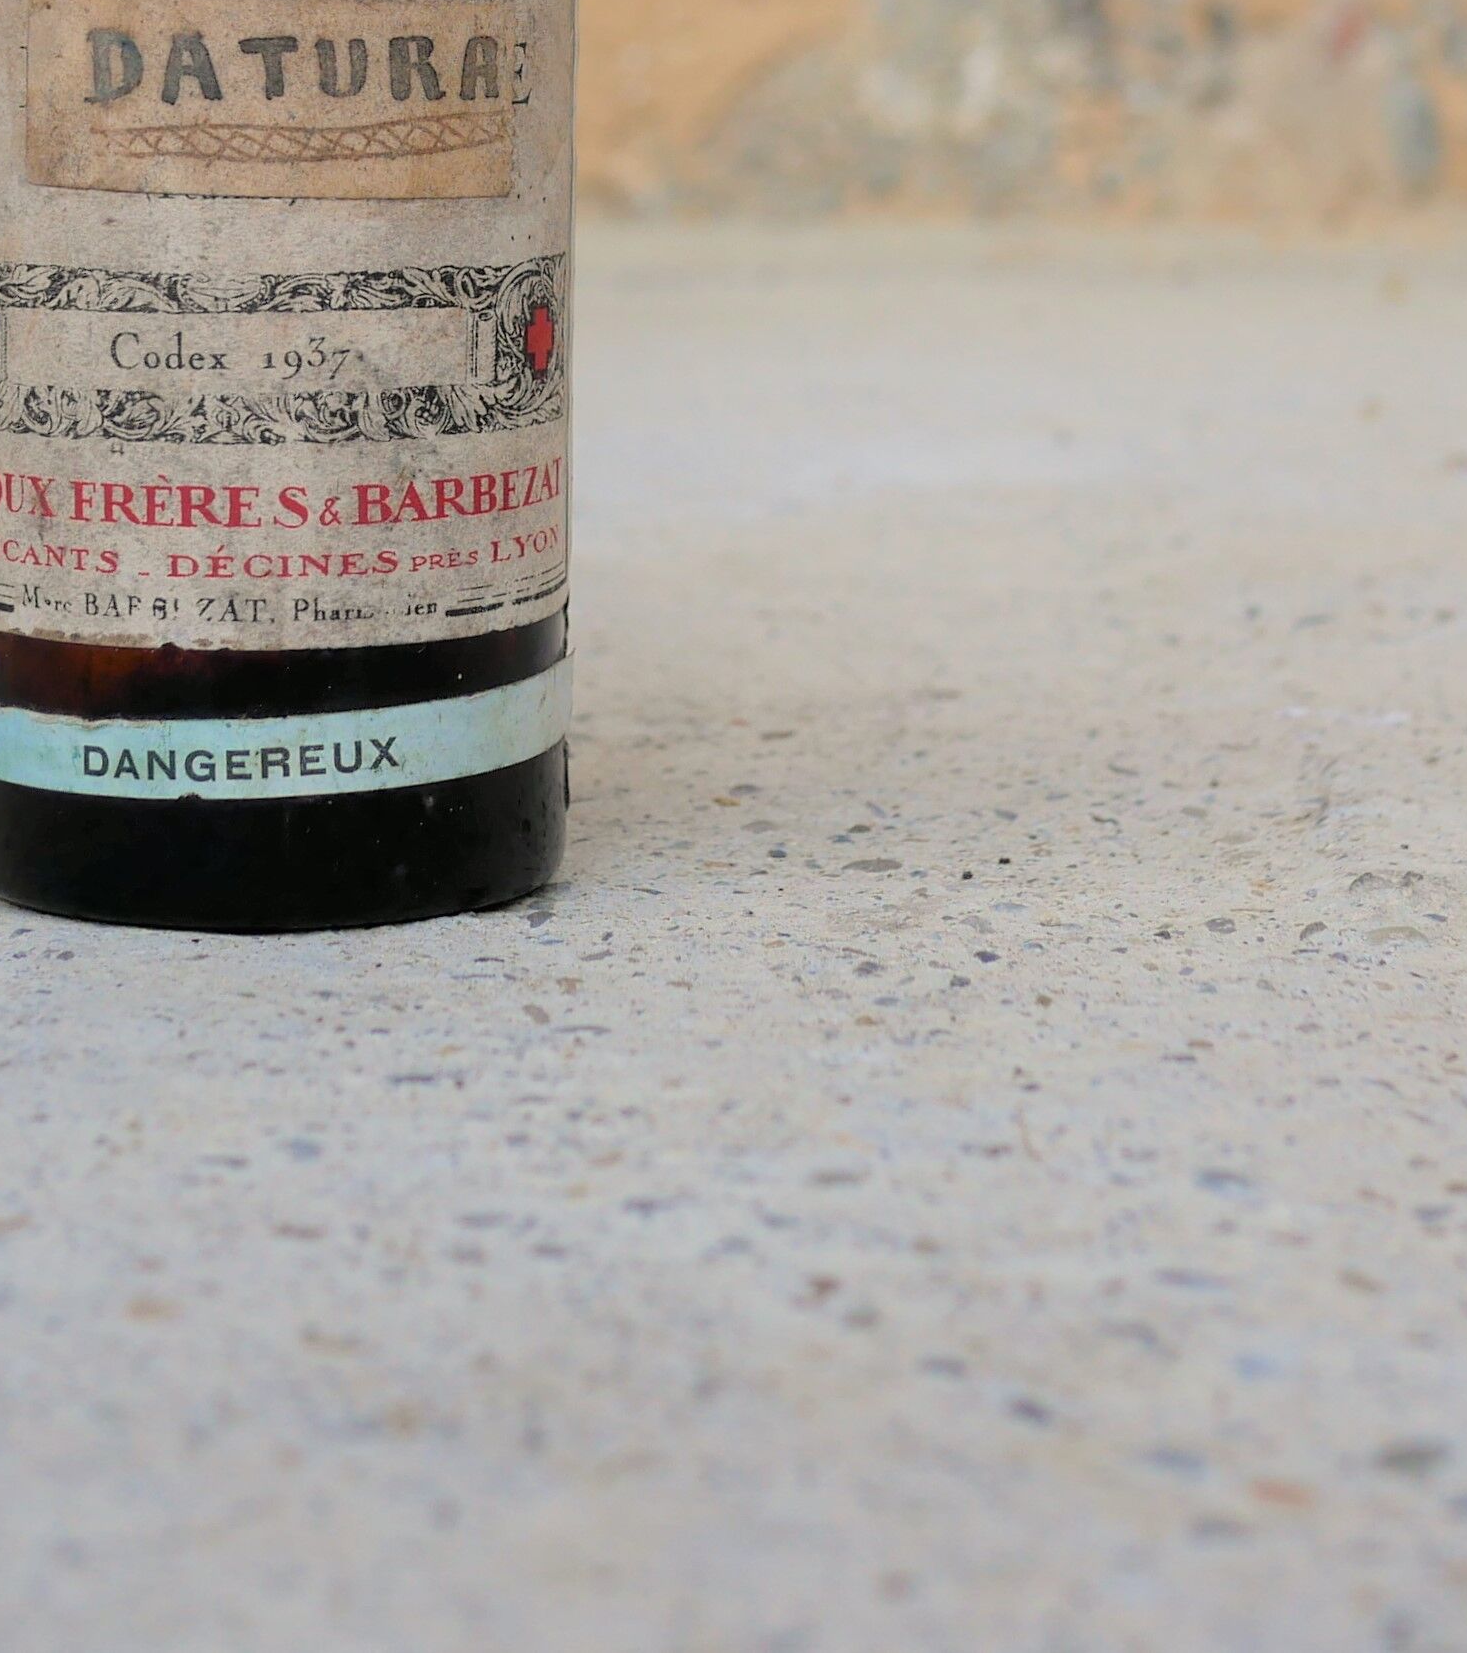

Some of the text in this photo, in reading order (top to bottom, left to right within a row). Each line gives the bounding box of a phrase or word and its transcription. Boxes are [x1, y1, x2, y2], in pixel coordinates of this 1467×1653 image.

[110, 331, 350, 380] Codex 1937
[69, 474, 311, 529] FRÈRES
[318, 496, 344, 526] &
[351, 457, 562, 529] BARBEZAT
[166, 544, 398, 579] DÉCINES
[490, 524, 558, 563] LYON
[22, 584, 72, 613] Mrc
[83, 736, 399, 781] DANGEREUX
